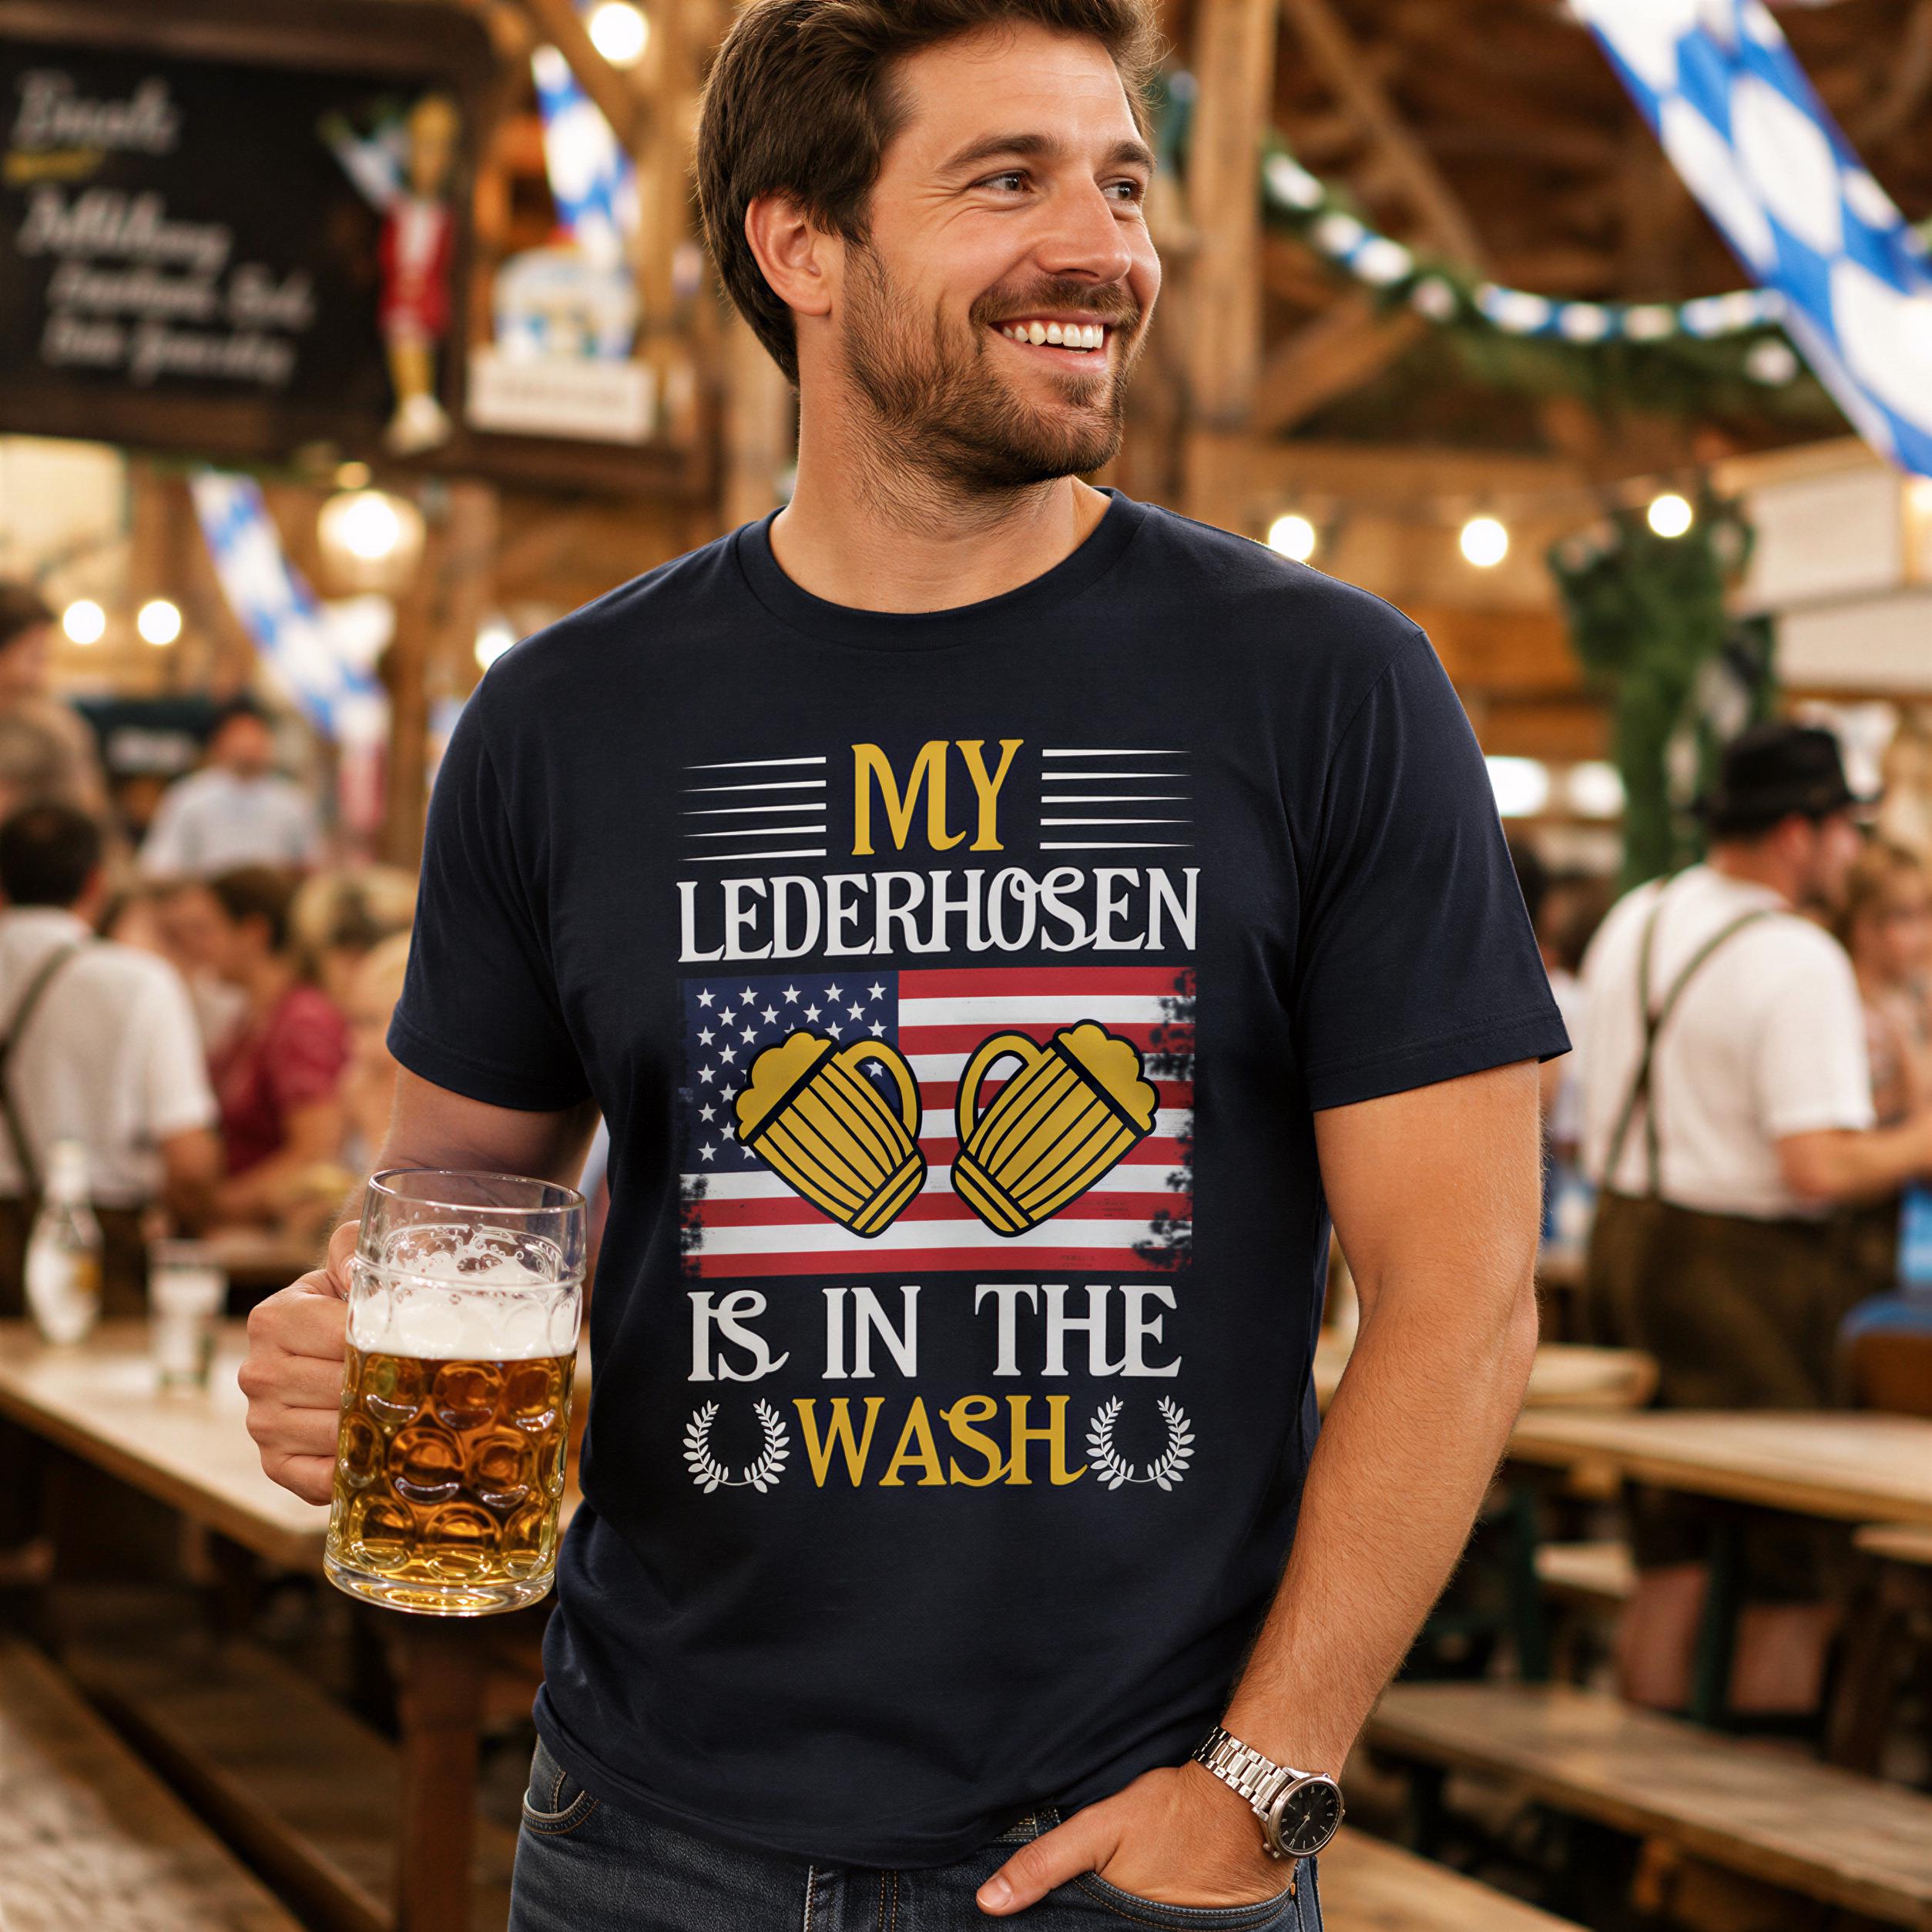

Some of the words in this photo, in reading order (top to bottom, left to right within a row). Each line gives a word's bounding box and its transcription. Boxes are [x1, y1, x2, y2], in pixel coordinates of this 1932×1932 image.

[850, 739, 1024, 856] MY
[676, 867, 1201, 963] LEDERHOSEN
[686, 1290, 790, 1382] IS
[821, 1285, 921, 1379] IN
[974, 1284, 1182, 1377] THE
[792, 1394, 1088, 1488] WASH
